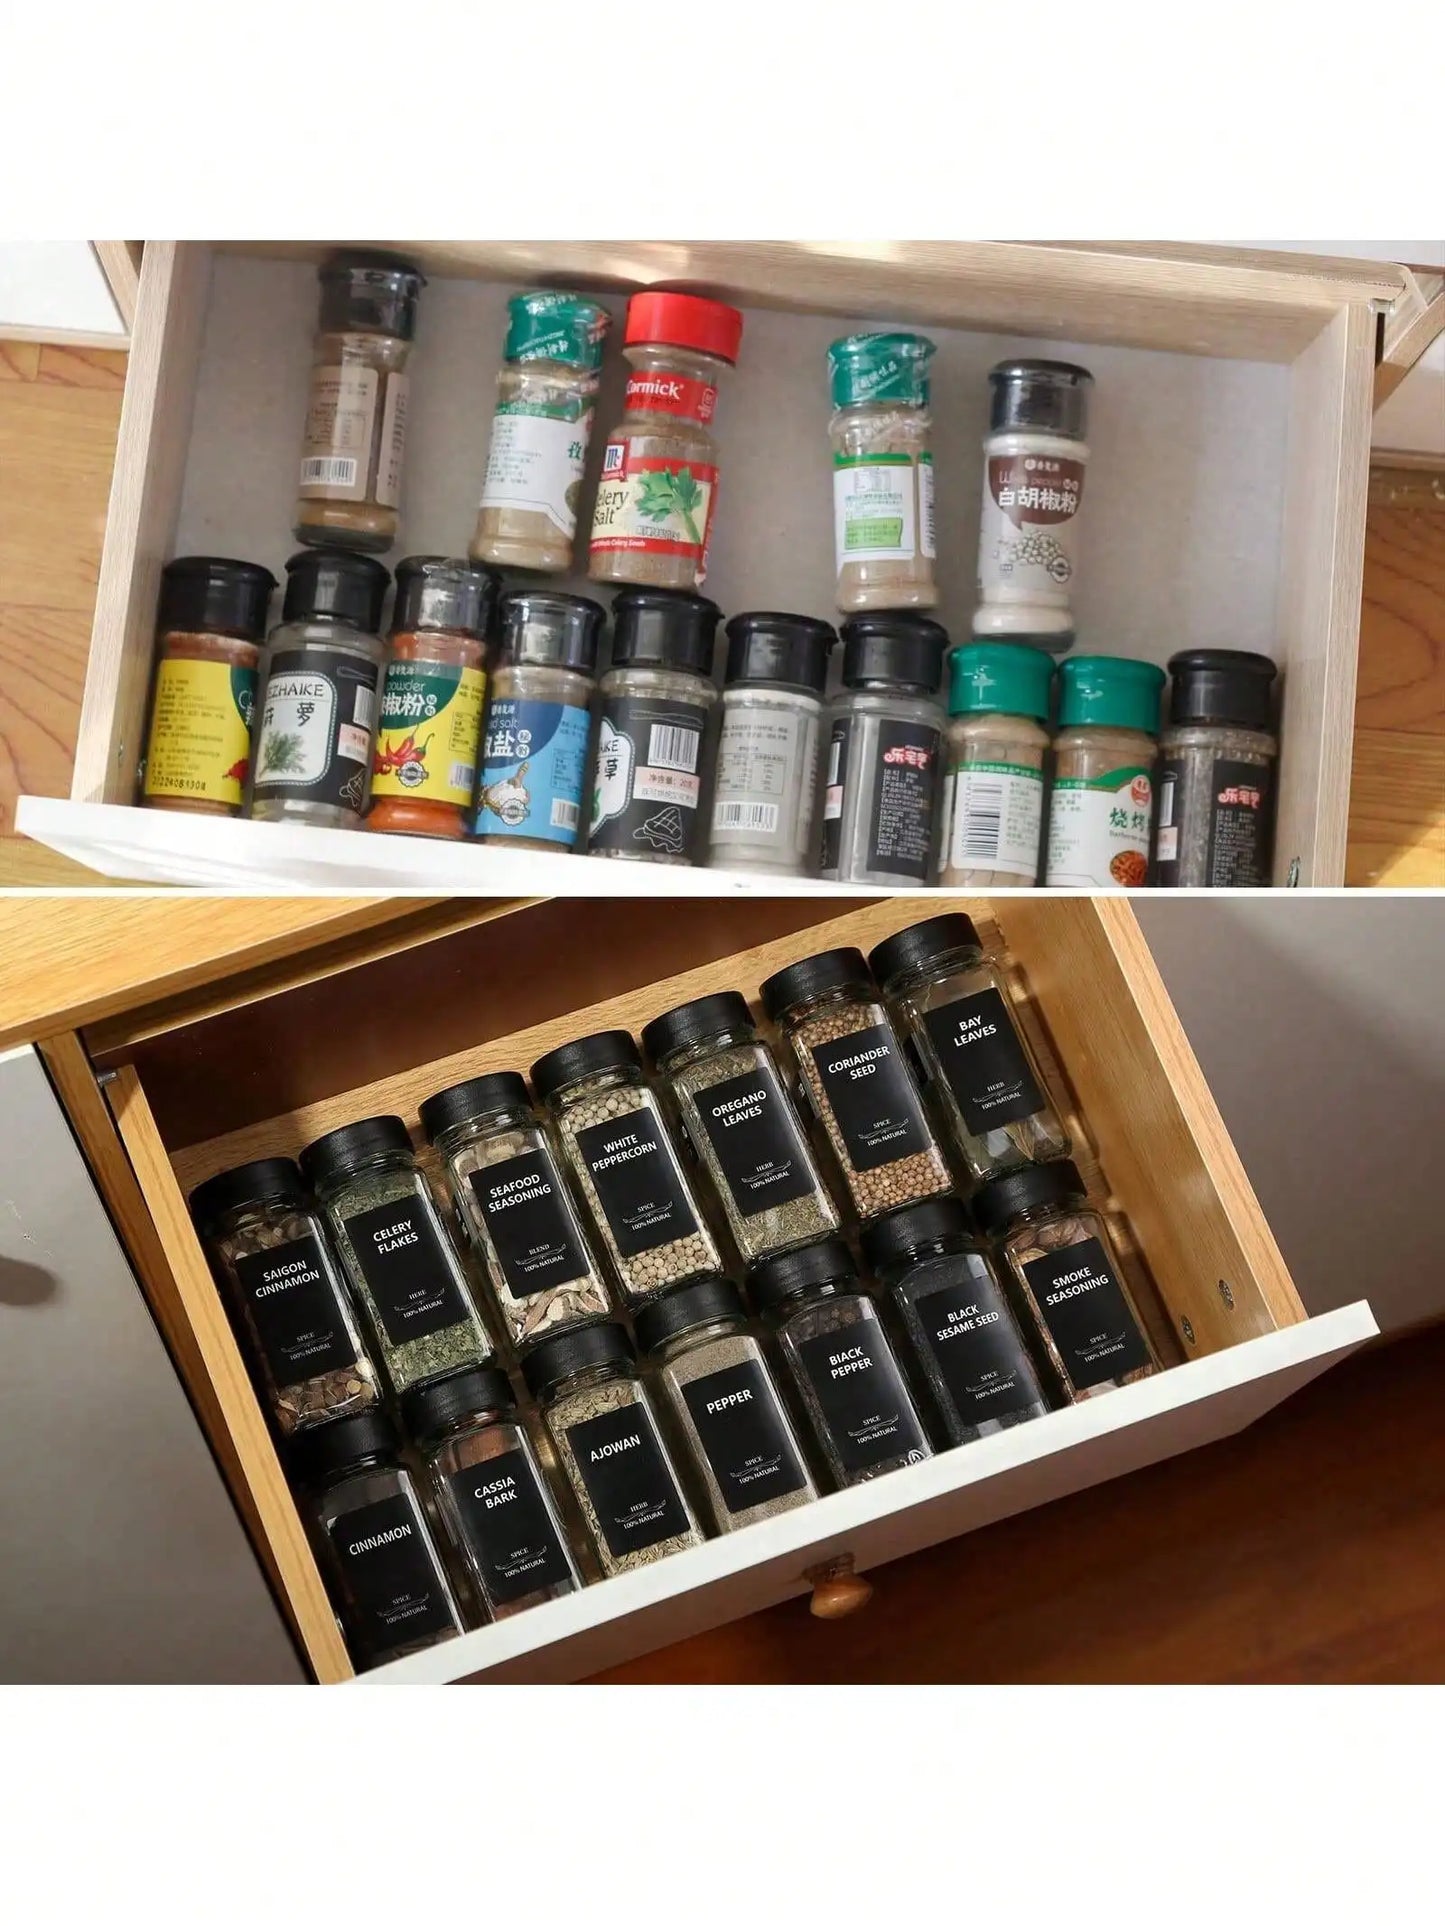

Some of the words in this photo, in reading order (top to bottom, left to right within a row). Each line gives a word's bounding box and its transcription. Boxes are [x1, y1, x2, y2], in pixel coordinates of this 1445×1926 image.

[998, 486, 1077, 514] 白胡椒粉
[958, 1015, 983, 1032] BAY
[953, 1024, 998, 1047] LEAVES
[828, 1045, 891, 1075] CORIANDER
[850, 1064, 877, 1080] SEED
[712, 1090, 767, 1117] OREGANO
[981, 1100, 997, 1110] 100%
[996, 1091, 1021, 1105] NATURAL
[722, 1105, 763, 1127] LEAVES
[603, 1134, 639, 1154] WHITE
[867, 1138, 882, 1147] 100%
[882, 1128, 908, 1142] NATURAL
[591, 1141, 658, 1172] PEPPERCORN
[489, 1174, 541, 1198] SEAFOOD
[750, 1179, 765, 1190] 100%
[765, 1170, 790, 1185] NATURAL
[488, 1183, 552, 1213] SEASONING
[373, 1220, 413, 1242] CELERY
[631, 1220, 646, 1231] 100%
[646, 1212, 672, 1226] NATURAL
[377, 1232, 419, 1255] FLAKES
[528, 1244, 550, 1256] BLEND
[263, 1260, 307, 1282] SAIGON
[524, 1263, 539, 1273] 100%
[539, 1255, 565, 1268] NATURAL
[255, 1269, 321, 1298] CINNAMON
[1052, 1266, 1093, 1289] SMOKE
[1045, 1274, 1110, 1306] SEASONING
[403, 1310, 419, 1319] 100%
[418, 1300, 443, 1314] NATURAL
[947, 1304, 981, 1323] BLACK
[936, 1318, 976, 1341] SESAME
[976, 1311, 1000, 1327] SEED
[290, 1351, 305, 1361] 100%
[305, 1342, 332, 1357] NATURAL
[1084, 1352, 1100, 1363] 100%
[1099, 1342, 1125, 1358] NATURAL
[830, 1357, 873, 1379] PEPPER
[975, 1389, 990, 1400] 100%
[989, 1380, 1016, 1395] NATURAL
[706, 1389, 754, 1414] PEPPER
[857, 1433, 872, 1445] 100%
[872, 1425, 898, 1439] NATURAL
[590, 1434, 641, 1462] AJOWAN
[739, 1473, 754, 1485] 100%
[754, 1464, 780, 1479] NATURAL
[474, 1476, 516, 1499] CASSIA
[485, 1489, 518, 1509] BARK
[623, 1519, 638, 1530] 100%
[638, 1509, 665, 1524] NATURAL
[349, 1524, 412, 1556] CINNAMON
[504, 1566, 520, 1578] 100%
[519, 1557, 546, 1572] NATURAL
[386, 1613, 402, 1625] 100%
[402, 1604, 428, 1619] NATURAL
